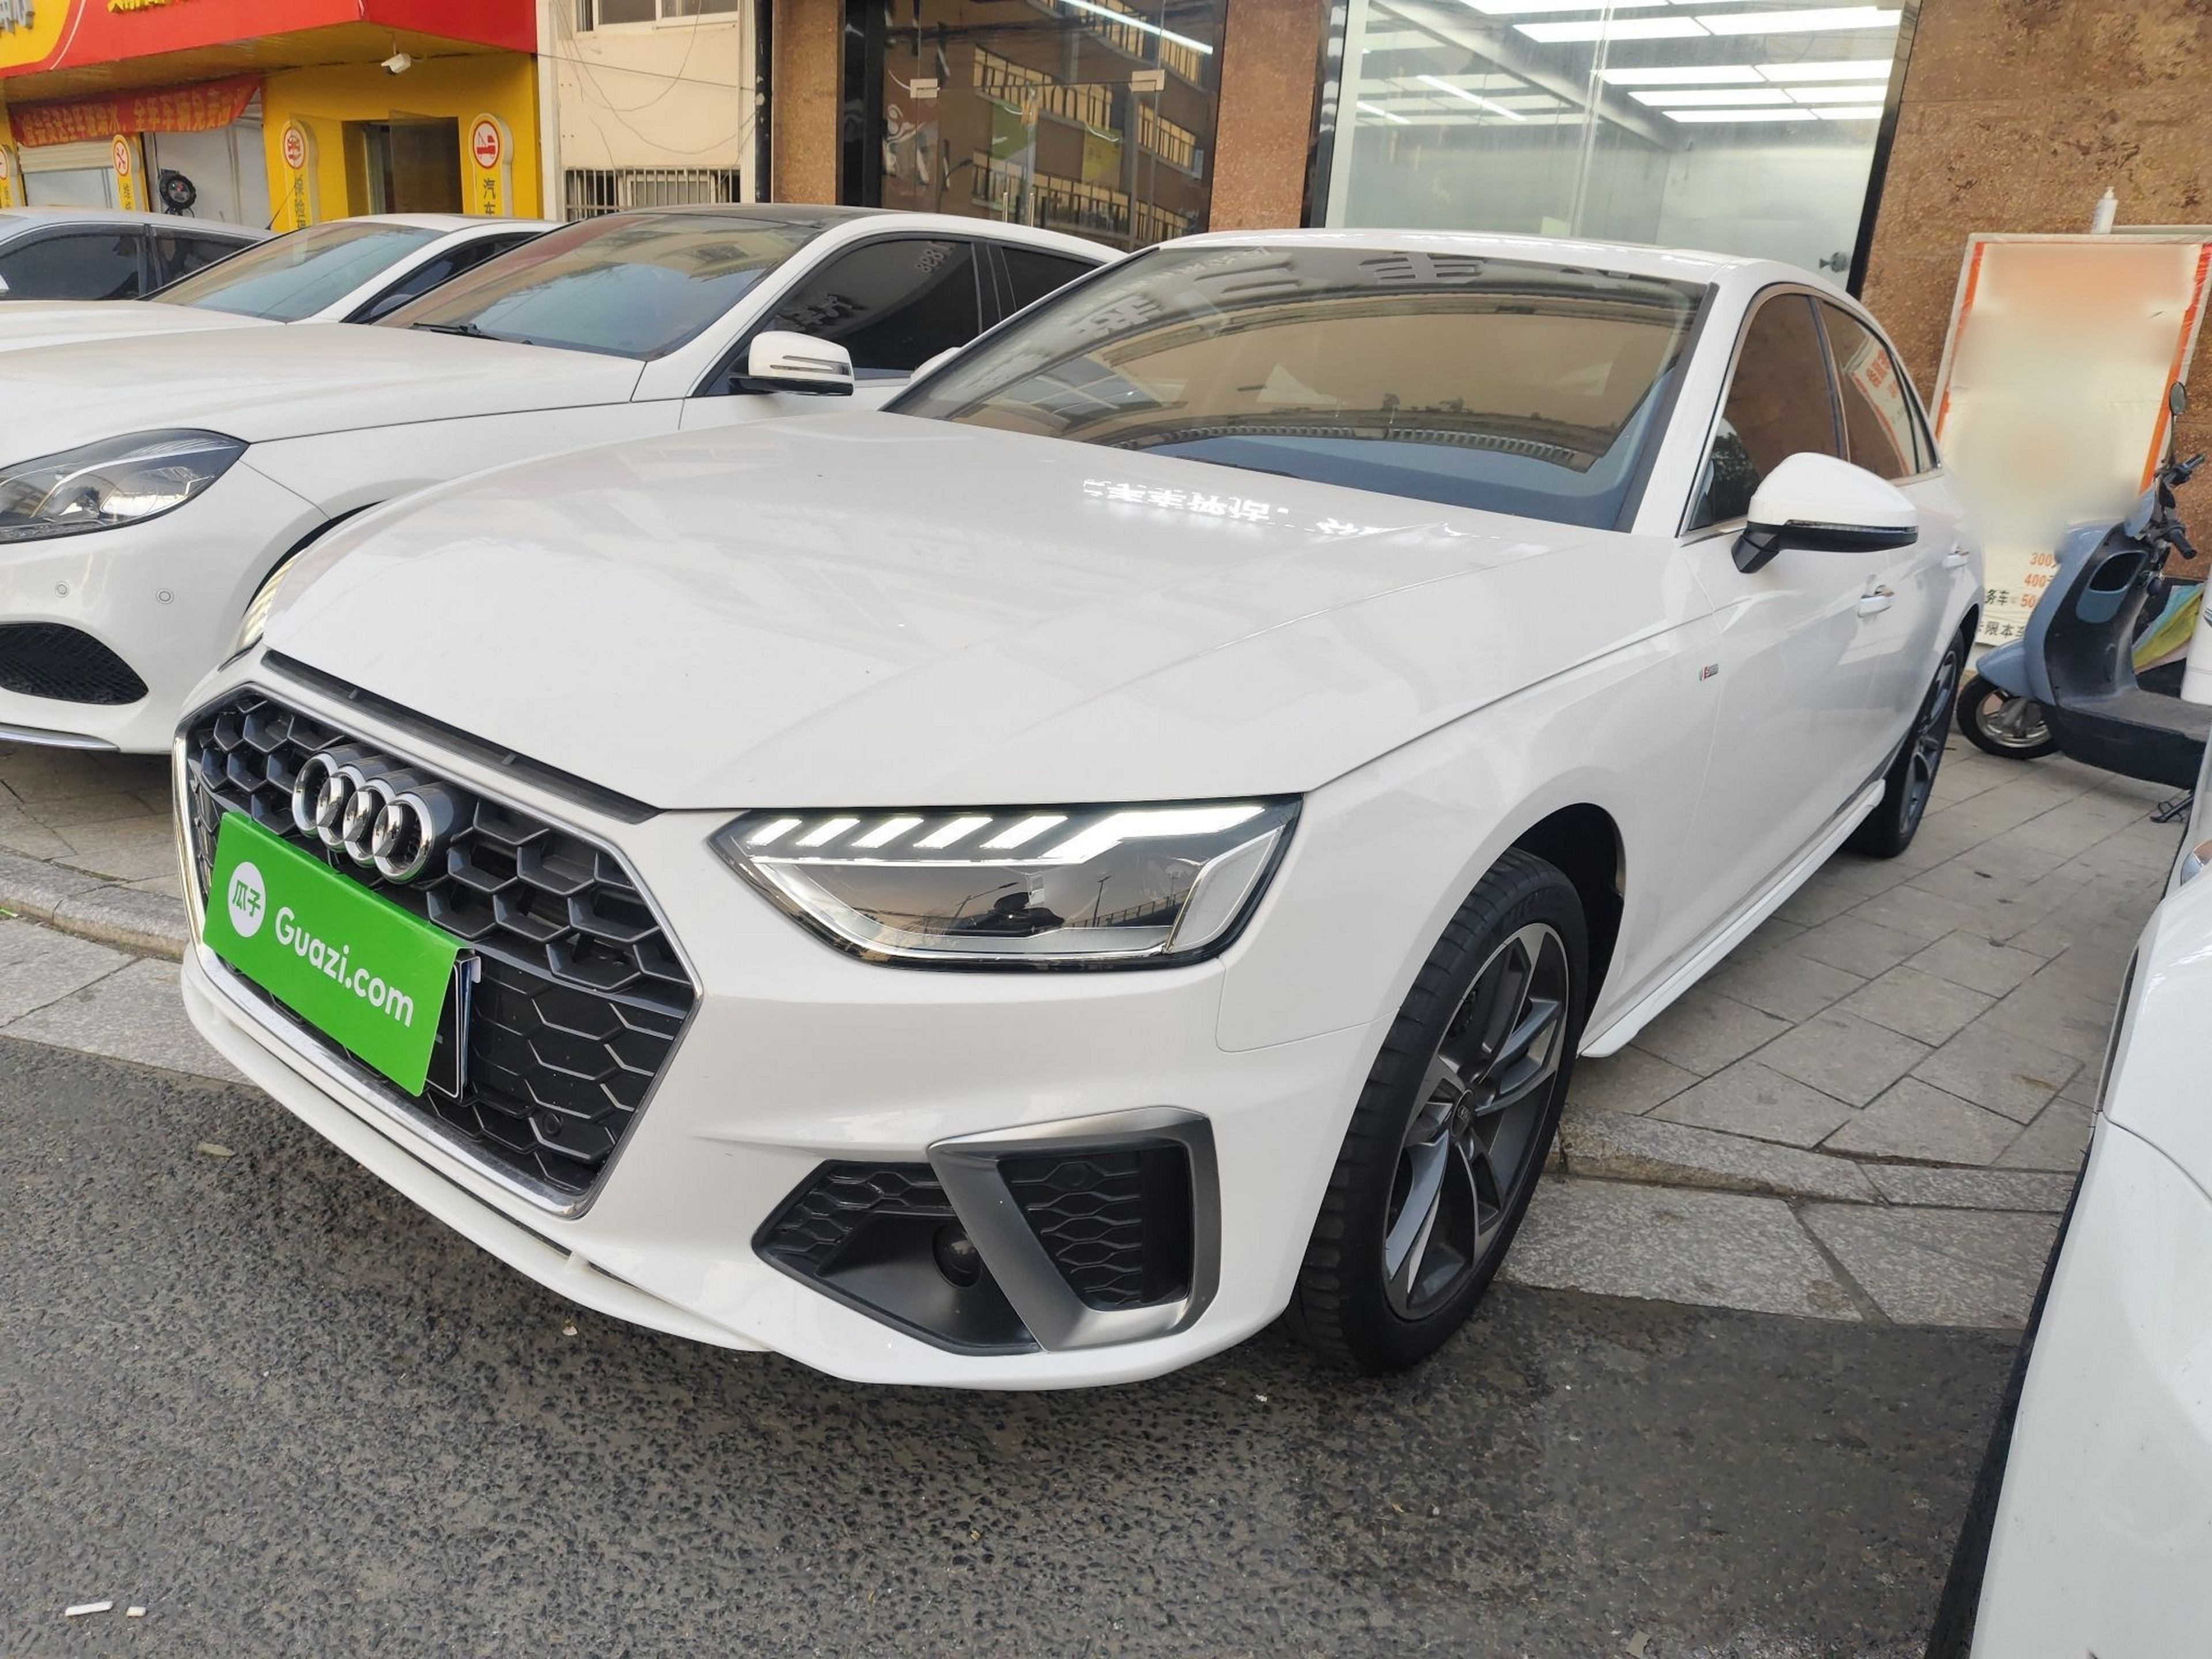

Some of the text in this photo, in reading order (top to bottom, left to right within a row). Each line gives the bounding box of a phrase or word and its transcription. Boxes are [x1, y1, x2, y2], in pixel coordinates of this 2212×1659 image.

[2021, 593, 2040, 608] 50
[232, 878, 261, 918] 瓜子
[275, 906, 414, 1027] Guazi.com
